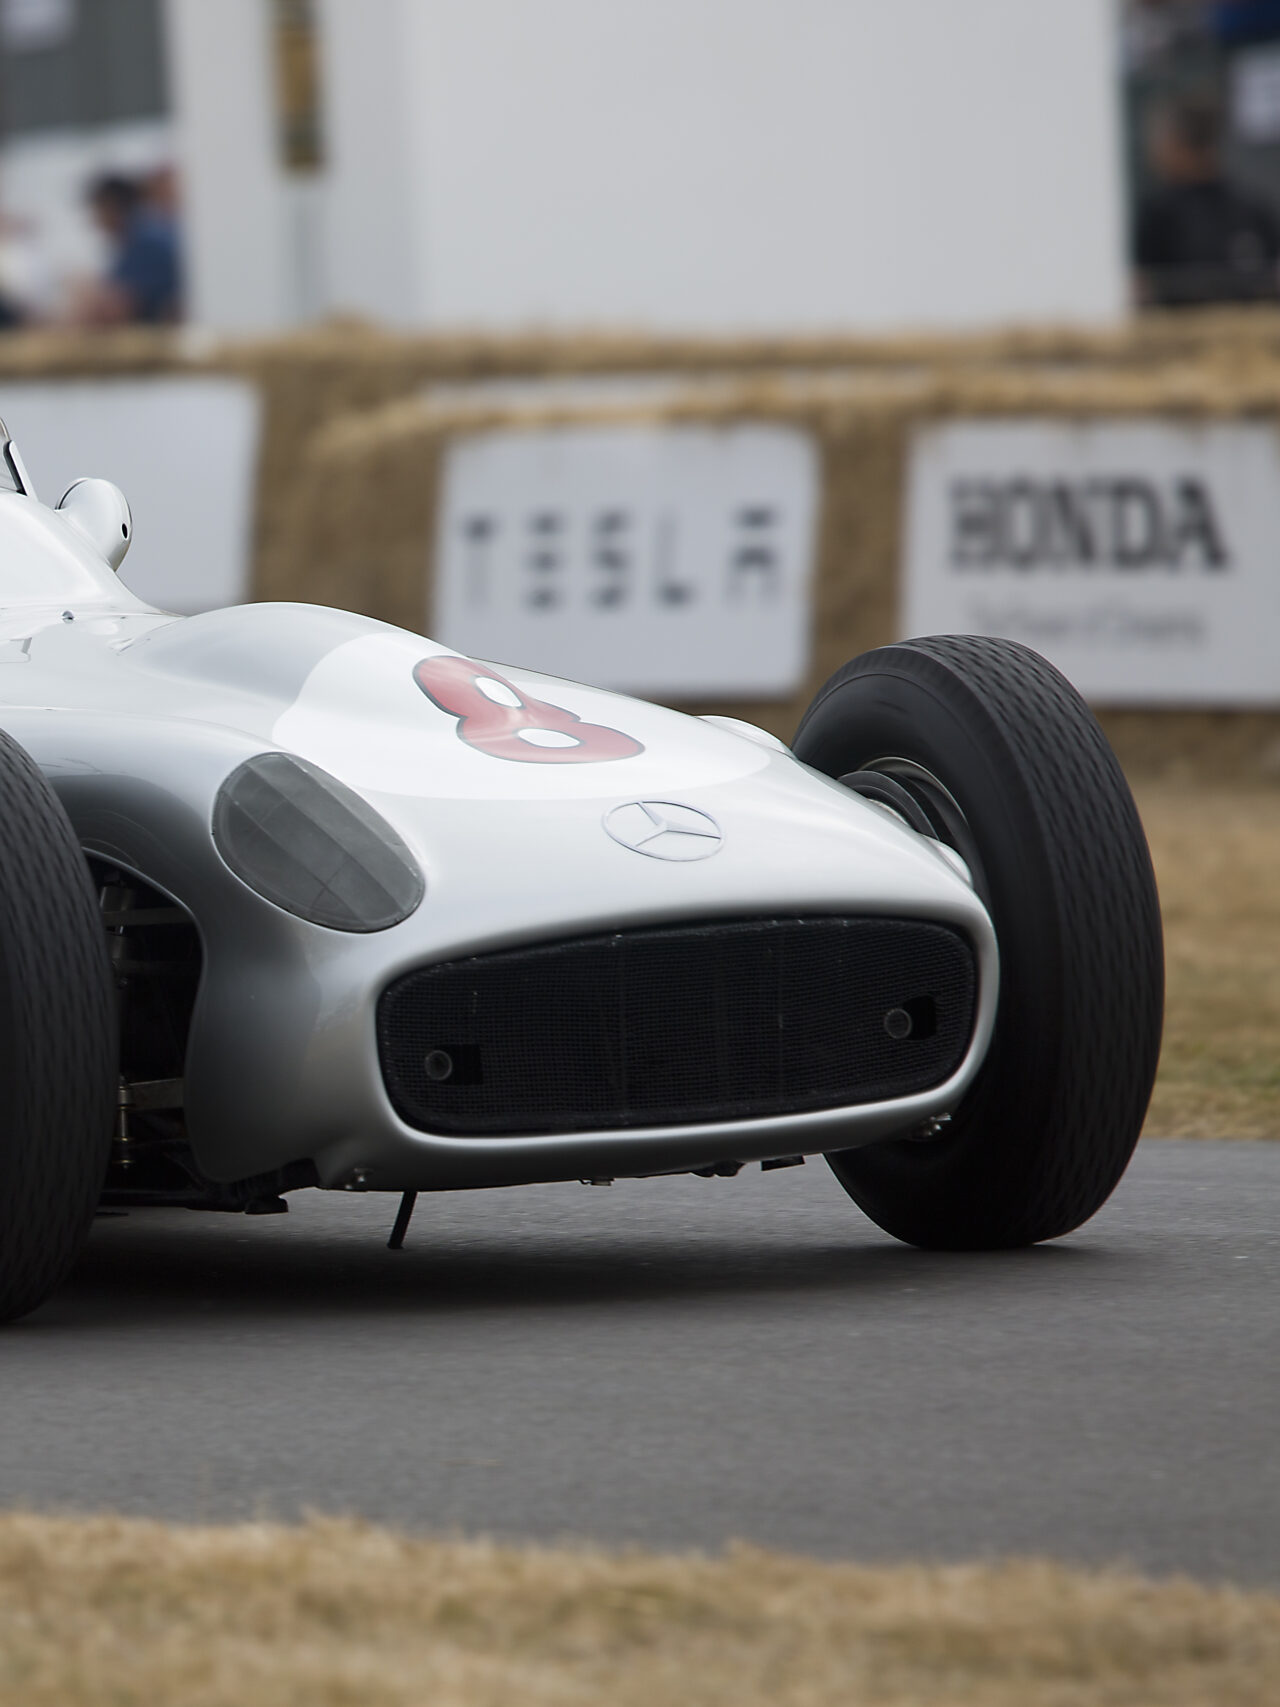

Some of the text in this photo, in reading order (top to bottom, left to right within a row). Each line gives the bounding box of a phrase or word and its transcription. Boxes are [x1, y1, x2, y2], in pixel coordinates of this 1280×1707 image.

[462, 509, 778, 611] TESLA
[951, 474, 1232, 574] HONDA
[412, 655, 645, 764] 8
